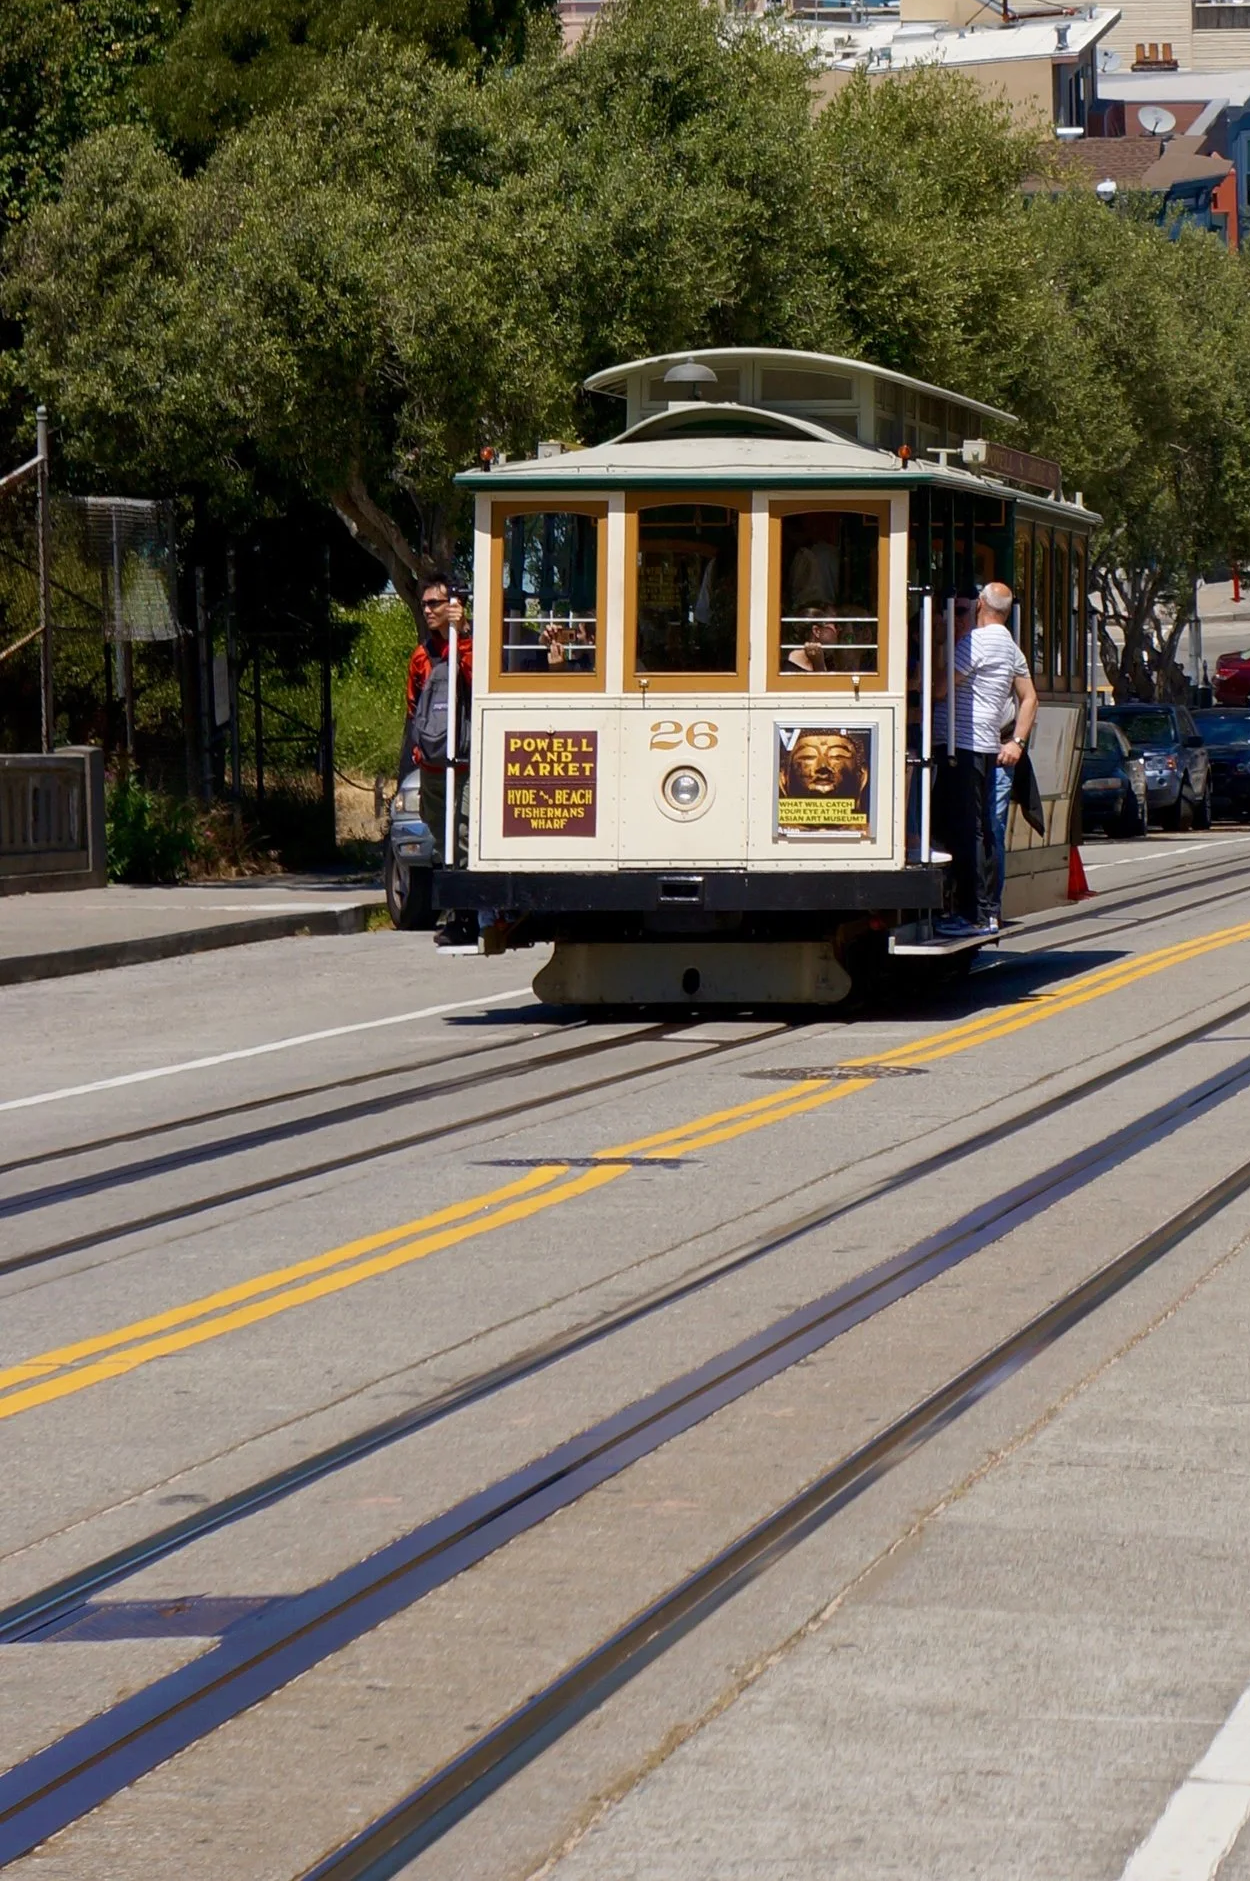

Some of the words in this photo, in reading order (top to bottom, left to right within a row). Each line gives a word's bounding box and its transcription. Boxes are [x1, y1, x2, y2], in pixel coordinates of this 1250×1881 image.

[650, 720, 719, 752] 26
[510, 737, 594, 752] POWELL
[531, 752, 572, 762] AND
[507, 762, 595, 776] MARKET
[507, 789, 537, 805] HYDE
[555, 789, 592, 805] BEACH
[779, 801, 802, 809] WHAT
[804, 801, 824, 809] WILL
[825, 801, 853, 809] CATCH
[514, 807, 585, 819] FISHERMANS
[779, 815, 804, 823] ASIAN
[805, 815, 821, 823] ART
[823, 815, 864, 823] MUSEUM?
[530, 819, 567, 830] WHARF
